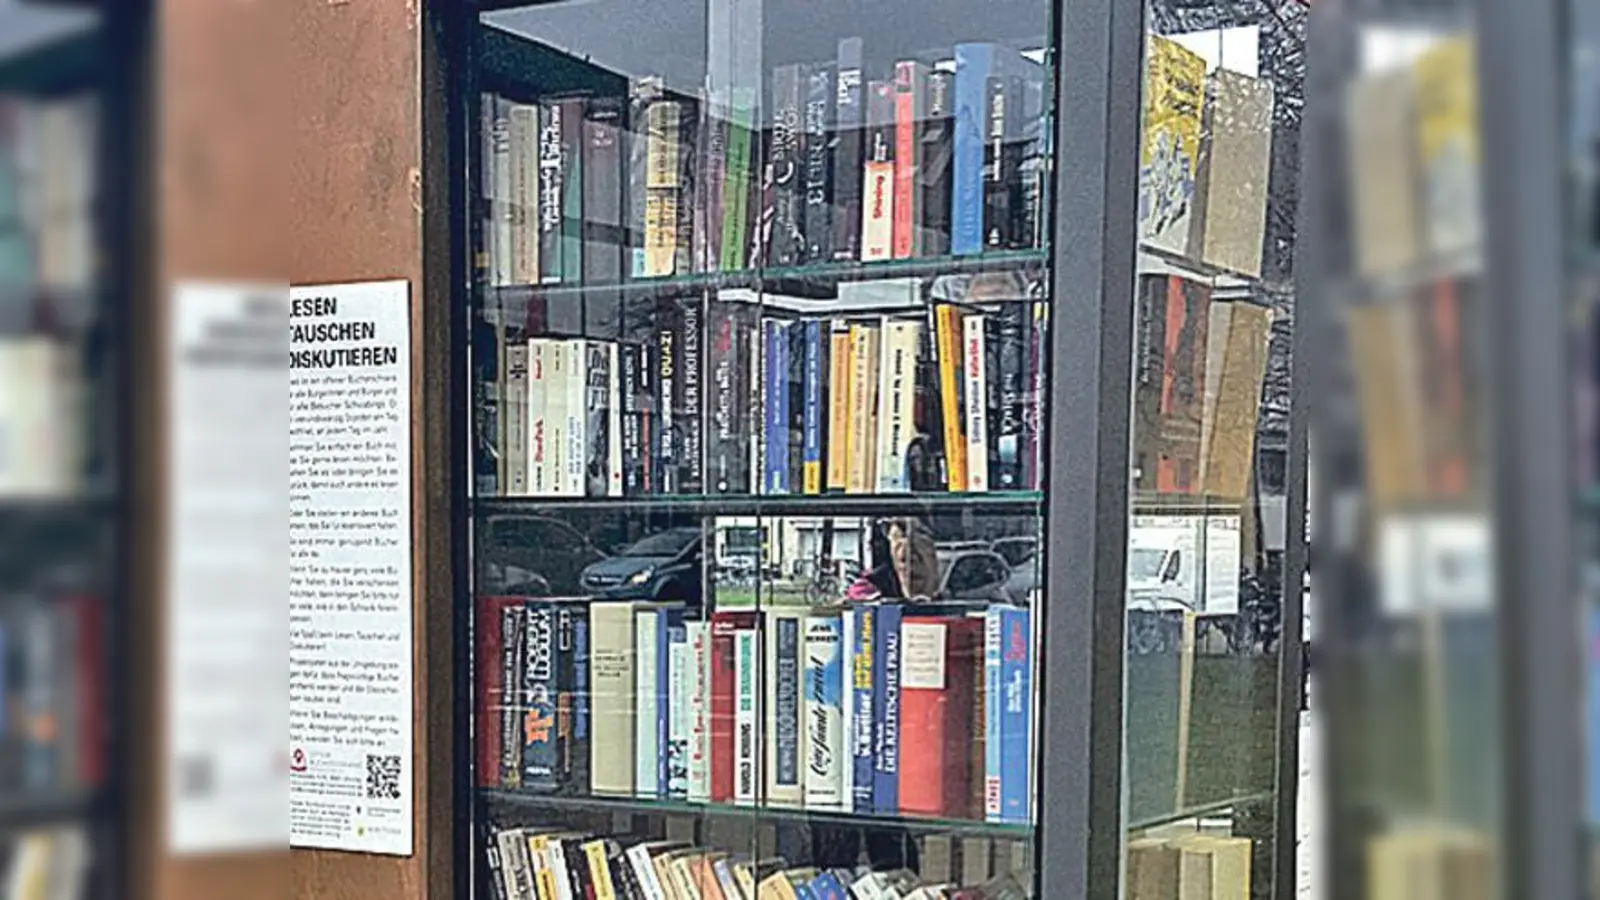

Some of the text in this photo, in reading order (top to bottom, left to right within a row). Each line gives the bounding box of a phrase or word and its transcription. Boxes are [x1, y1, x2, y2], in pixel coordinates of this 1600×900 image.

[290, 297, 336, 318] ESEN
[290, 322, 376, 344] AUSCHEN
[684, 307, 698, 385] PROFESSOR
